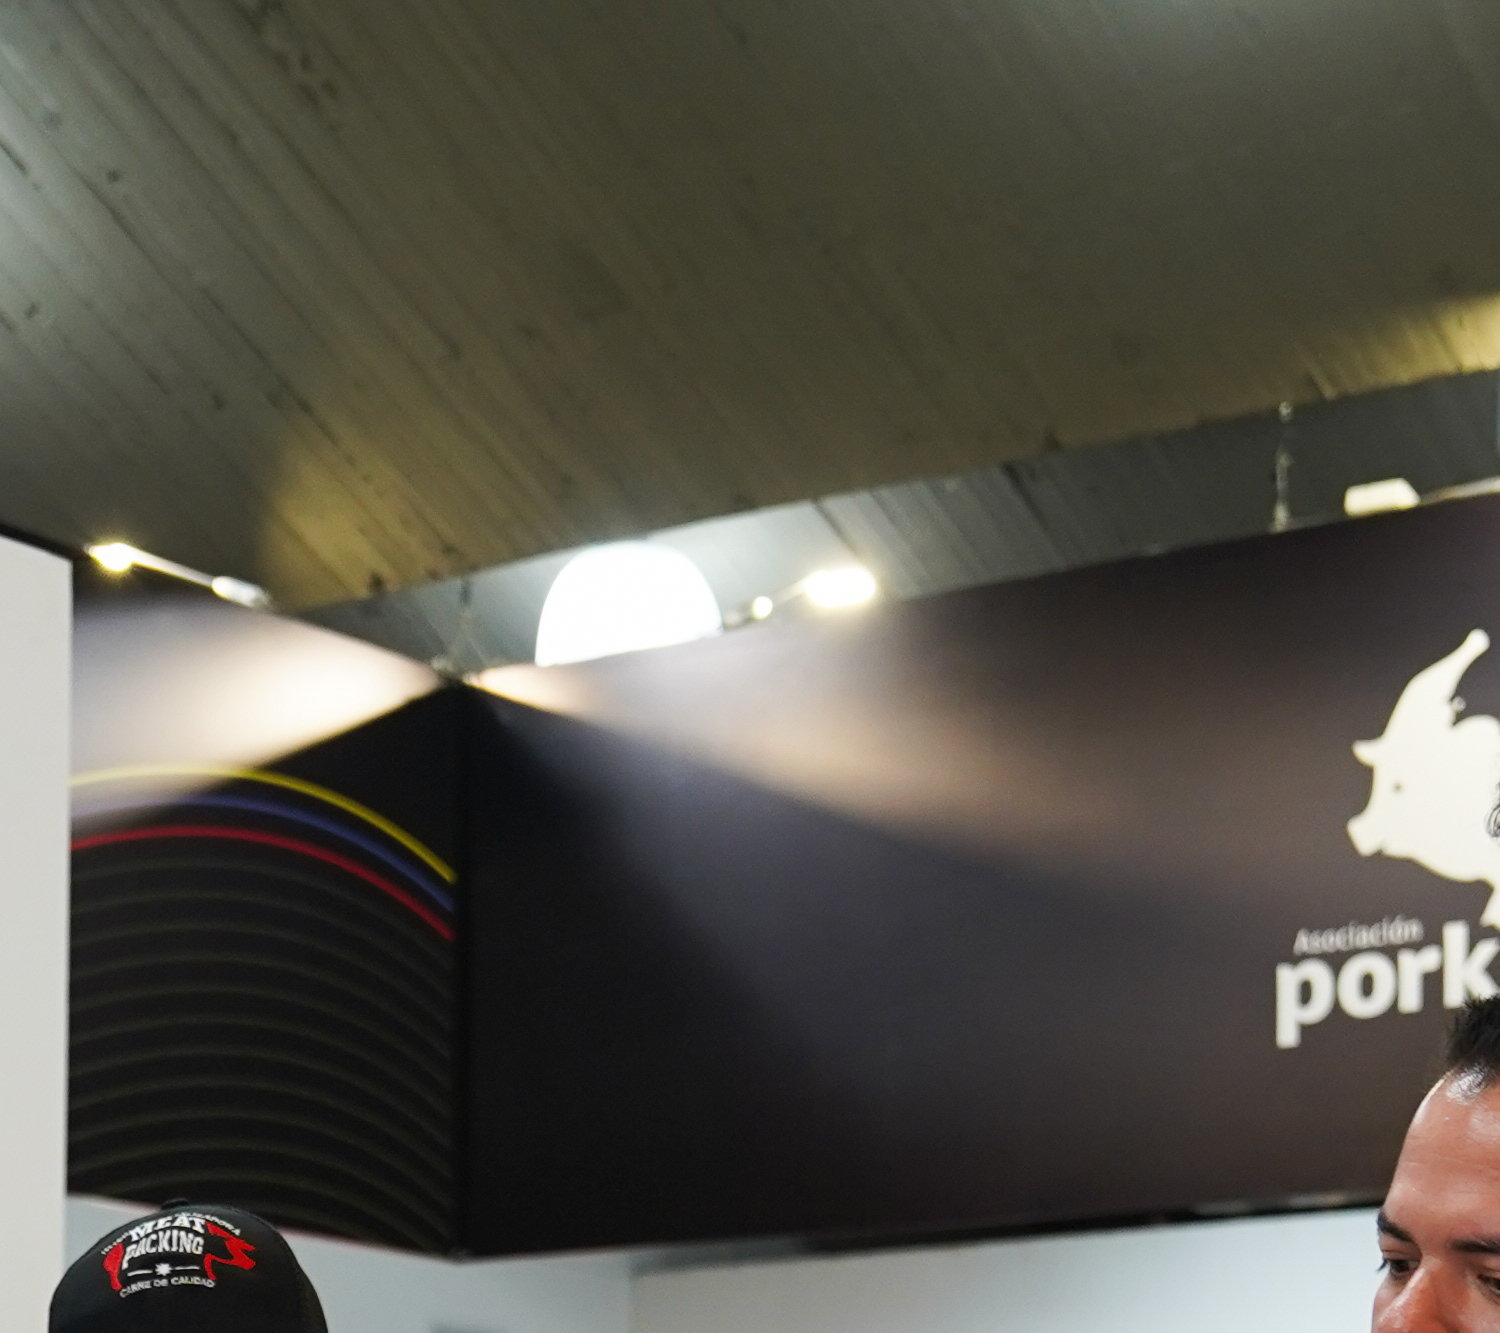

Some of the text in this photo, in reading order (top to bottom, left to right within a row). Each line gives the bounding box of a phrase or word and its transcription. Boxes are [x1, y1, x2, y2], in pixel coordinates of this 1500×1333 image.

[1293, 914, 1425, 956] Asociación
[129, 1214, 206, 1242] MEAT
[121, 1229, 205, 1270] PACKING
[119, 1276, 216, 1299] CARNE DE CALIDAD
